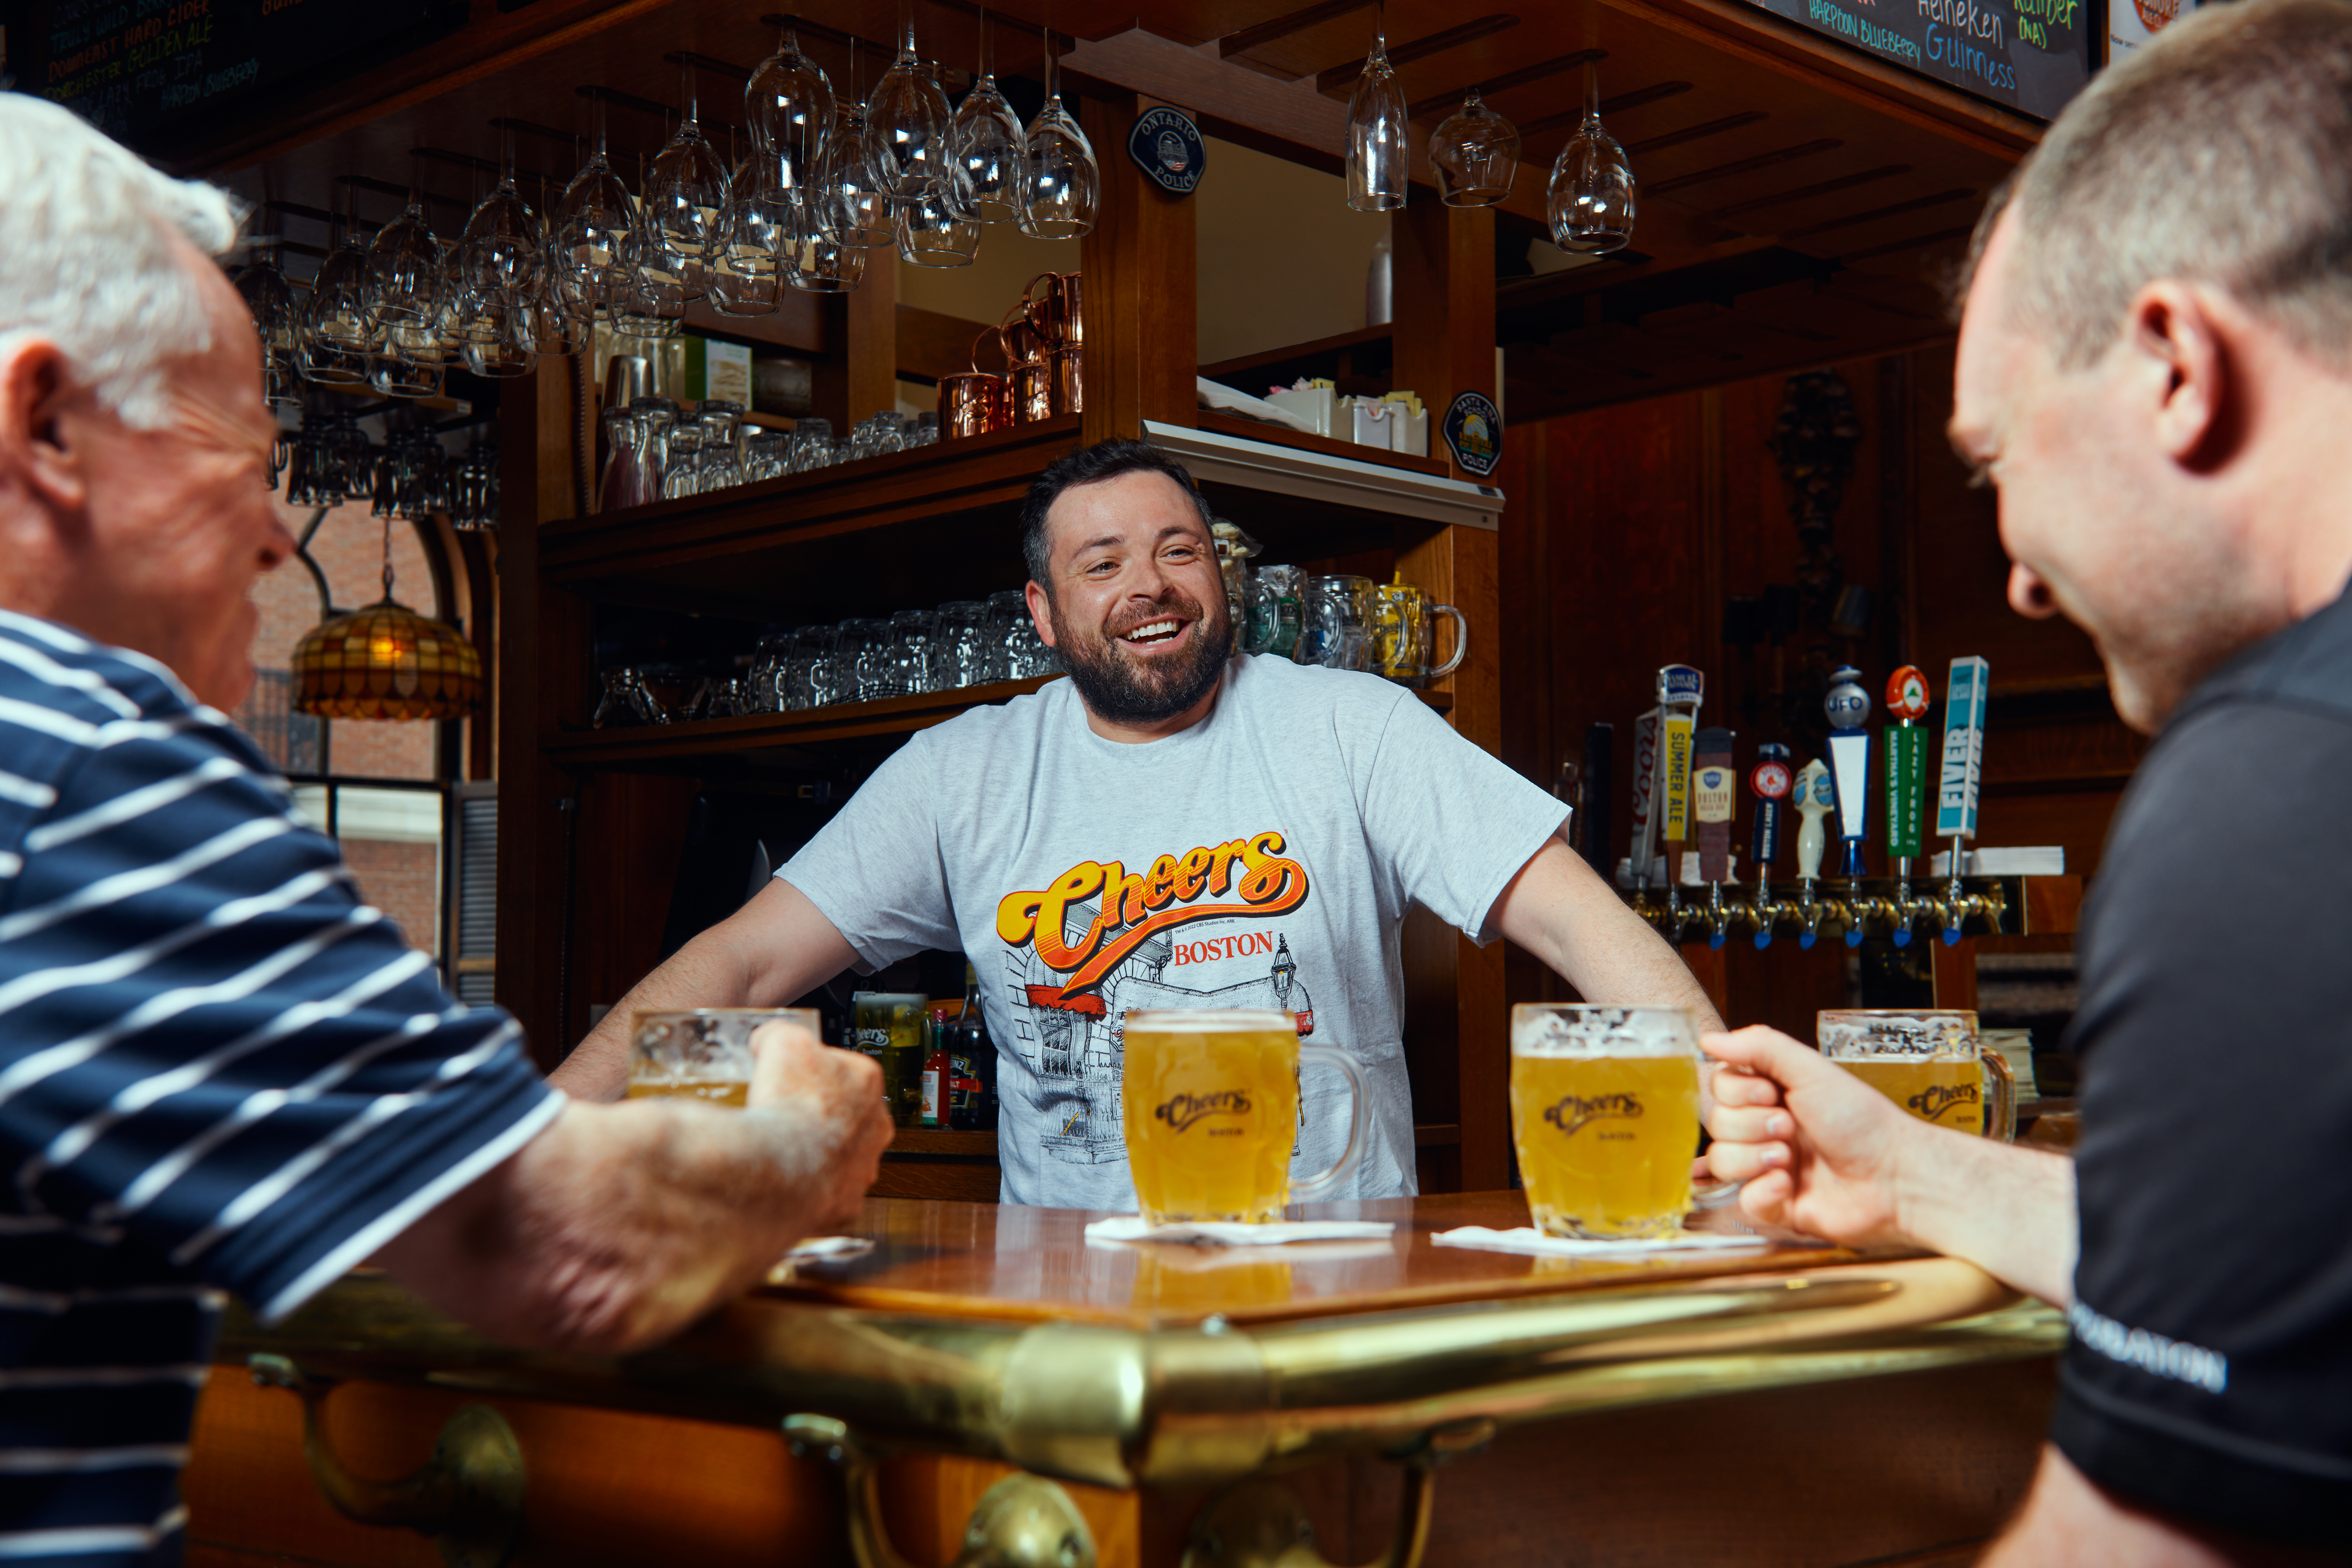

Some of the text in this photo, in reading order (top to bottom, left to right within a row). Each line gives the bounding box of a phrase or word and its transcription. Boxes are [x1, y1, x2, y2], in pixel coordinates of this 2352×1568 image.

[49, 20, 90, 54] TRULY
[95, 5, 128, 36] WILD
[124, 17, 163, 49] HARD
[167, 0, 210, 27] CIDER
[128, 30, 182, 72] GOLDEN
[186, 14, 214, 48] ALE
[1809, 0, 1921, 68] HARPOON BLUEBERRY
[173, 48, 203, 80] IPA
[1926, 22, 2015, 90] Guinness
[1141, 113, 1197, 142] ONTARIO
[1154, 165, 1196, 188] POLICE
[1462, 452, 1488, 469] POLICE
[1828, 696, 1863, 713] UFO
[1669, 731, 1686, 824] SUMMER ALE
[1908, 731, 1920, 835] LAZY FROG
[1941, 727, 1970, 810] FIVER
[997, 831, 1310, 1000] Cheers
[1173, 930, 1273, 966] BOSTON
[950, 1059, 965, 1071] EINZ
[1154, 1088, 1252, 1137] Cheers
[1543, 1091, 1645, 1139] Cheers
[1907, 1082, 1980, 1122] Cheers
